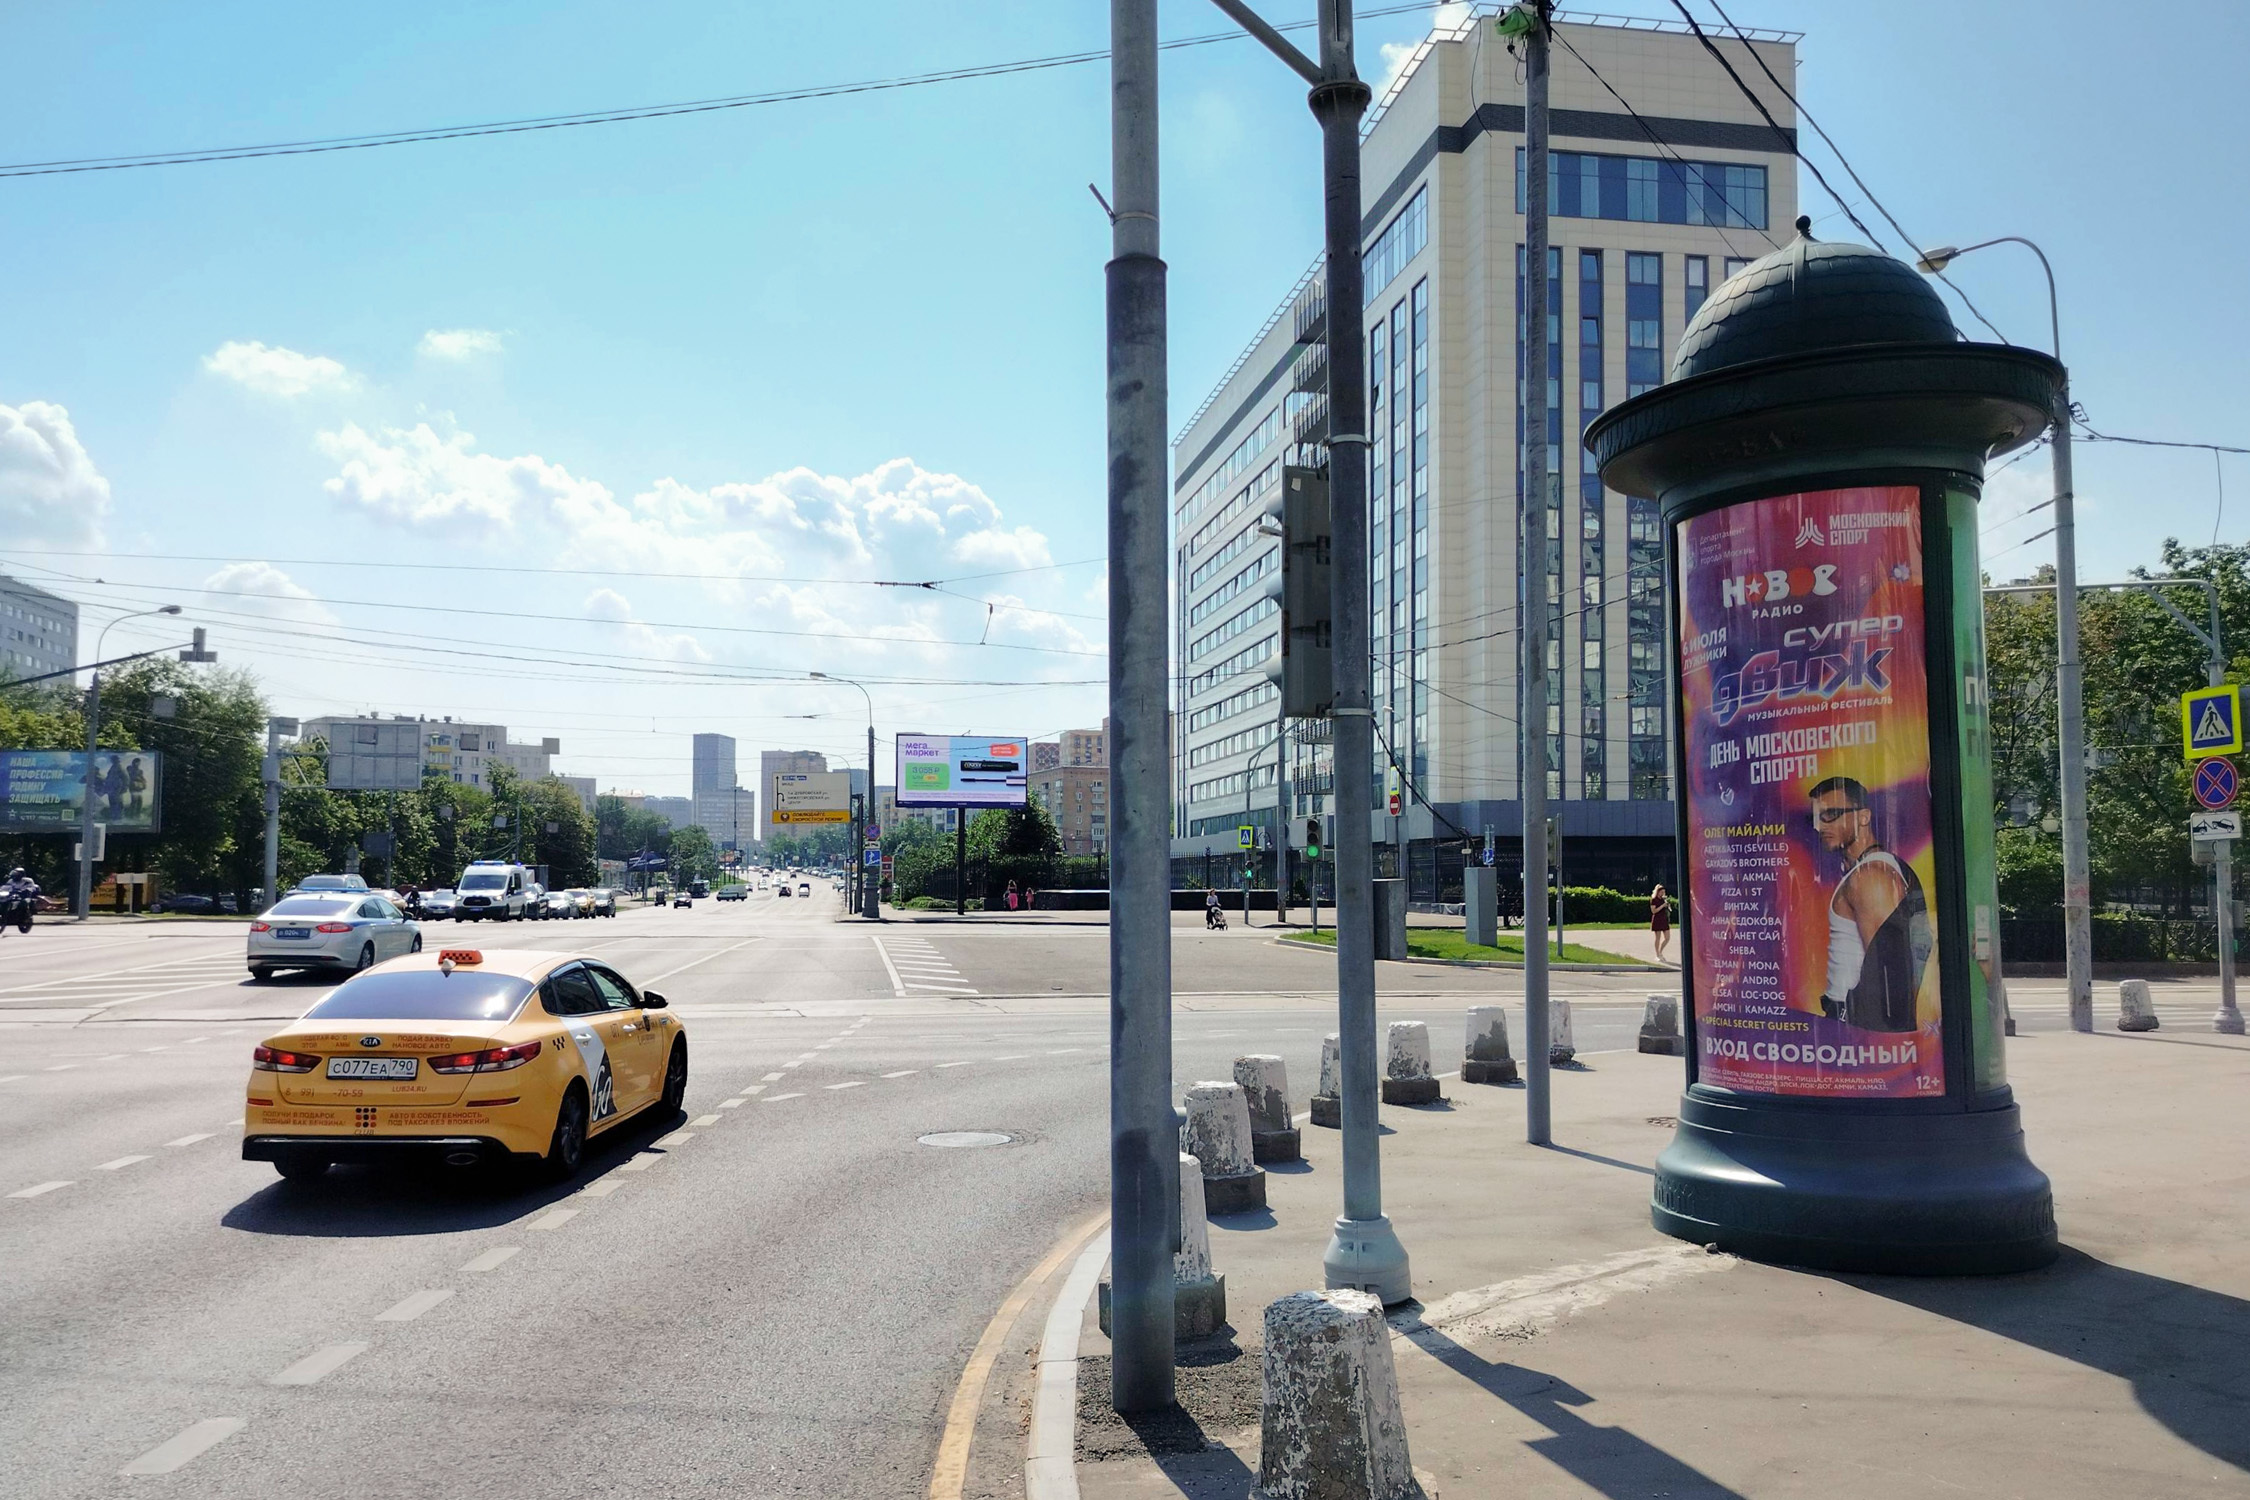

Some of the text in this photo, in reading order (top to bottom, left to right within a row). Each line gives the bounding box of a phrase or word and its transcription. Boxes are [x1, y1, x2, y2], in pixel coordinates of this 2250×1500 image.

[1829, 509, 1910, 531] МОСКОВСКИЙ
[1830, 528, 1869, 546] СПОРТ
[1723, 547, 1756, 559] Москвы
[1752, 604, 1803, 620] РАДИО
[1682, 627, 1727, 653] 6 ИЮЛЯ
[1683, 646, 1727, 669] ЛУЖНИКИ
[1747, 695, 1894, 721] МУЗЫКАЛЬНЫЙ ФЕСТИВАЛЬ
[1710, 720, 1877, 768] ДЕНЬ МОСКОВСКОГО
[10, 757, 37, 766] НАША
[10, 769, 64, 779] ПРОФЕССИЯ
[1750, 754, 1818, 785] СПОРТА
[9, 782, 46, 792] РОДИНУ
[8, 794, 61, 804] ЗАЩИЩАТЬ
[1704, 823, 1785, 838] ОЛЕГ МАЙАМИ
[1744, 843, 1789, 854] (SEVILLE)
[1705, 857, 1790, 868] GAYAZOVS BROTHERS
[1712, 873, 1734, 882] НЮША
[1721, 887, 1763, 896] PIZZA ST
[1724, 902, 1759, 911] ВИНТАЖ
[1711, 917, 1782, 926] АННА СЕДОКОВА
[1734, 931, 1756, 941] АНЕТ
[1758, 930, 1780, 941] САЙ
[1729, 946, 1756, 955] SHEBA
[1714, 960, 1780, 970] ELMAN MONA
[1742, 976, 1778, 986] ANDRO
[1712, 989, 1732, 998] ELSEA
[1712, 1002, 1787, 1016] AMCHI KAMAZZ
[1733, 1019, 1766, 1030] SECRET
[1767, 1021, 1809, 1032] GUESTS
[1706, 1037, 1917, 1066] ВХОД СВОБОДНЫЙ
[391, 1060, 413, 1071] 790
[1916, 1075, 1940, 1090] 12+
[447, 1118, 490, 1126] ВЛОЖЕНИЙ
